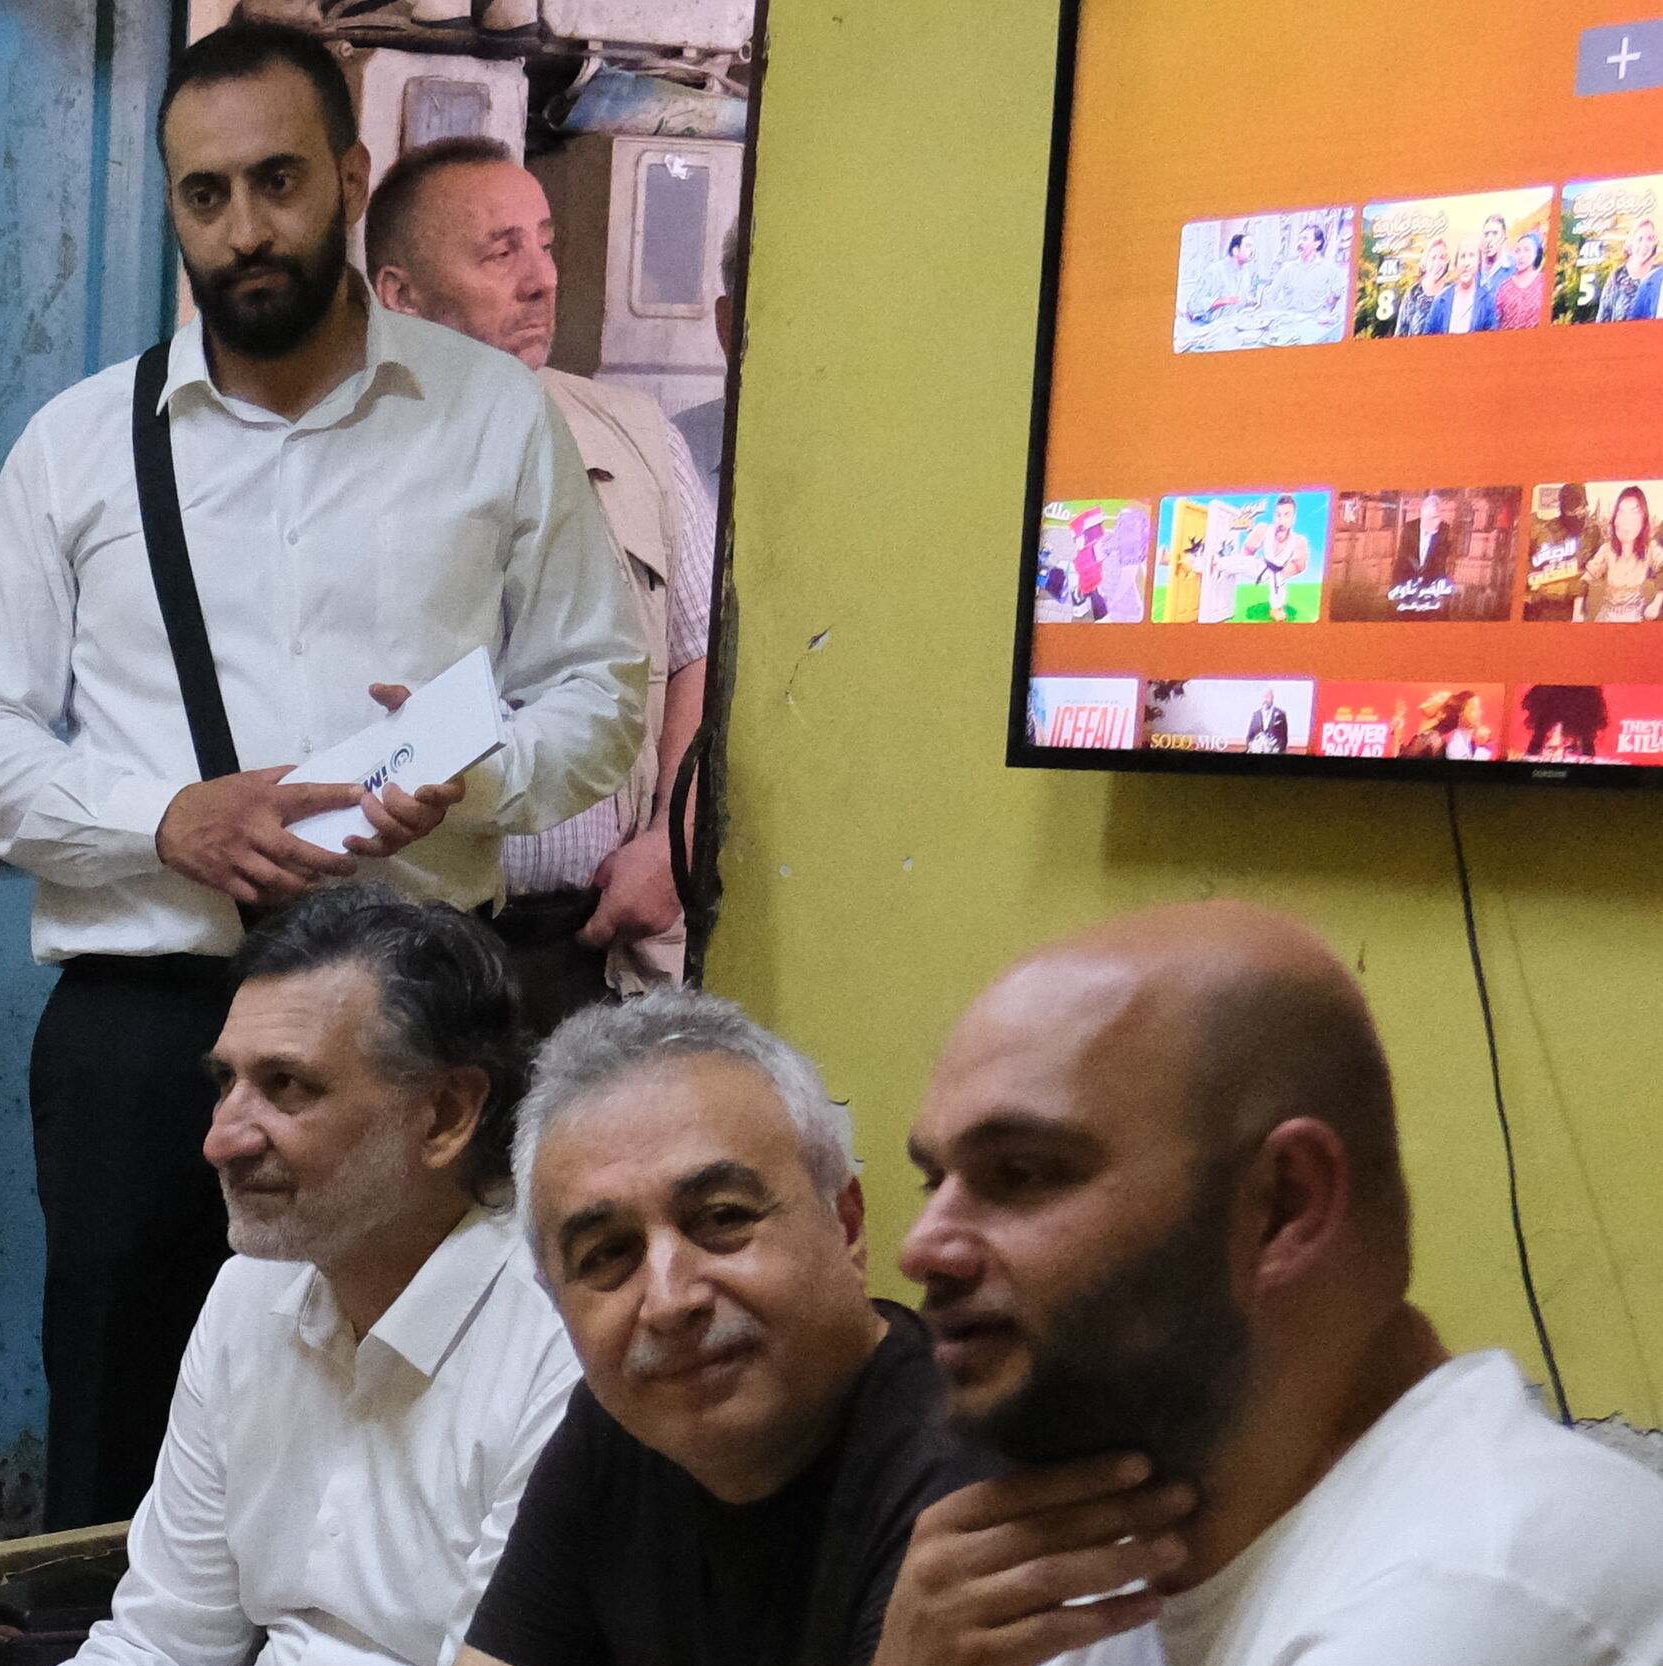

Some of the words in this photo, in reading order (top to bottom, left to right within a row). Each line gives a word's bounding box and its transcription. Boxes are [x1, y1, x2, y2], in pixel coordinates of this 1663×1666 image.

[1577, 273, 1596, 306] 5
[1376, 290, 1394, 320] 8
[1150, 734, 1194, 749] SOLO
[1322, 723, 1388, 750] POWER
